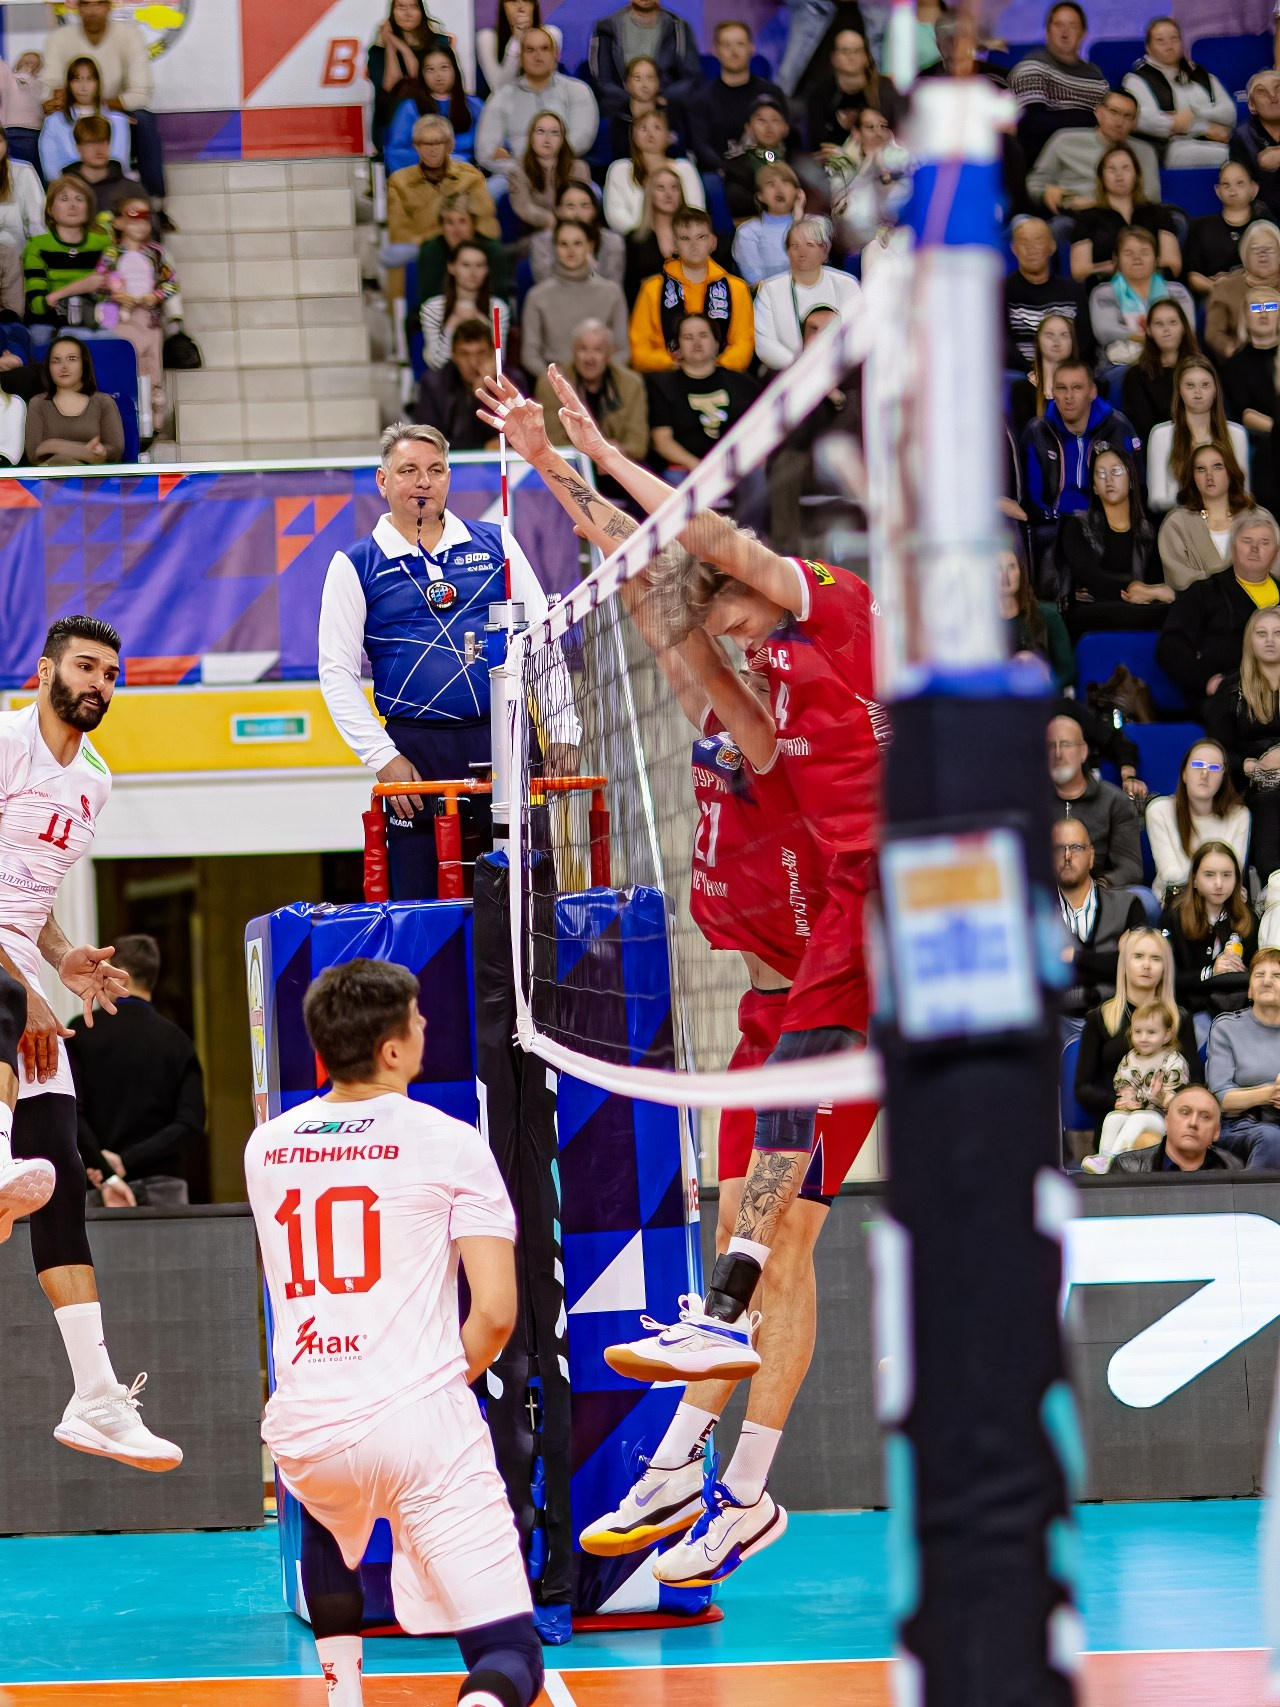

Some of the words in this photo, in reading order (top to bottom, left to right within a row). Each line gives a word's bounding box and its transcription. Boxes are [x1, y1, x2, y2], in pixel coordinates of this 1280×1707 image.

[38, 813, 73, 850] 11
[294, 1119, 375, 1134] PARI
[264, 1145, 400, 1166] МЕЛЬНИКОВ
[274, 1185, 382, 1300] 10
